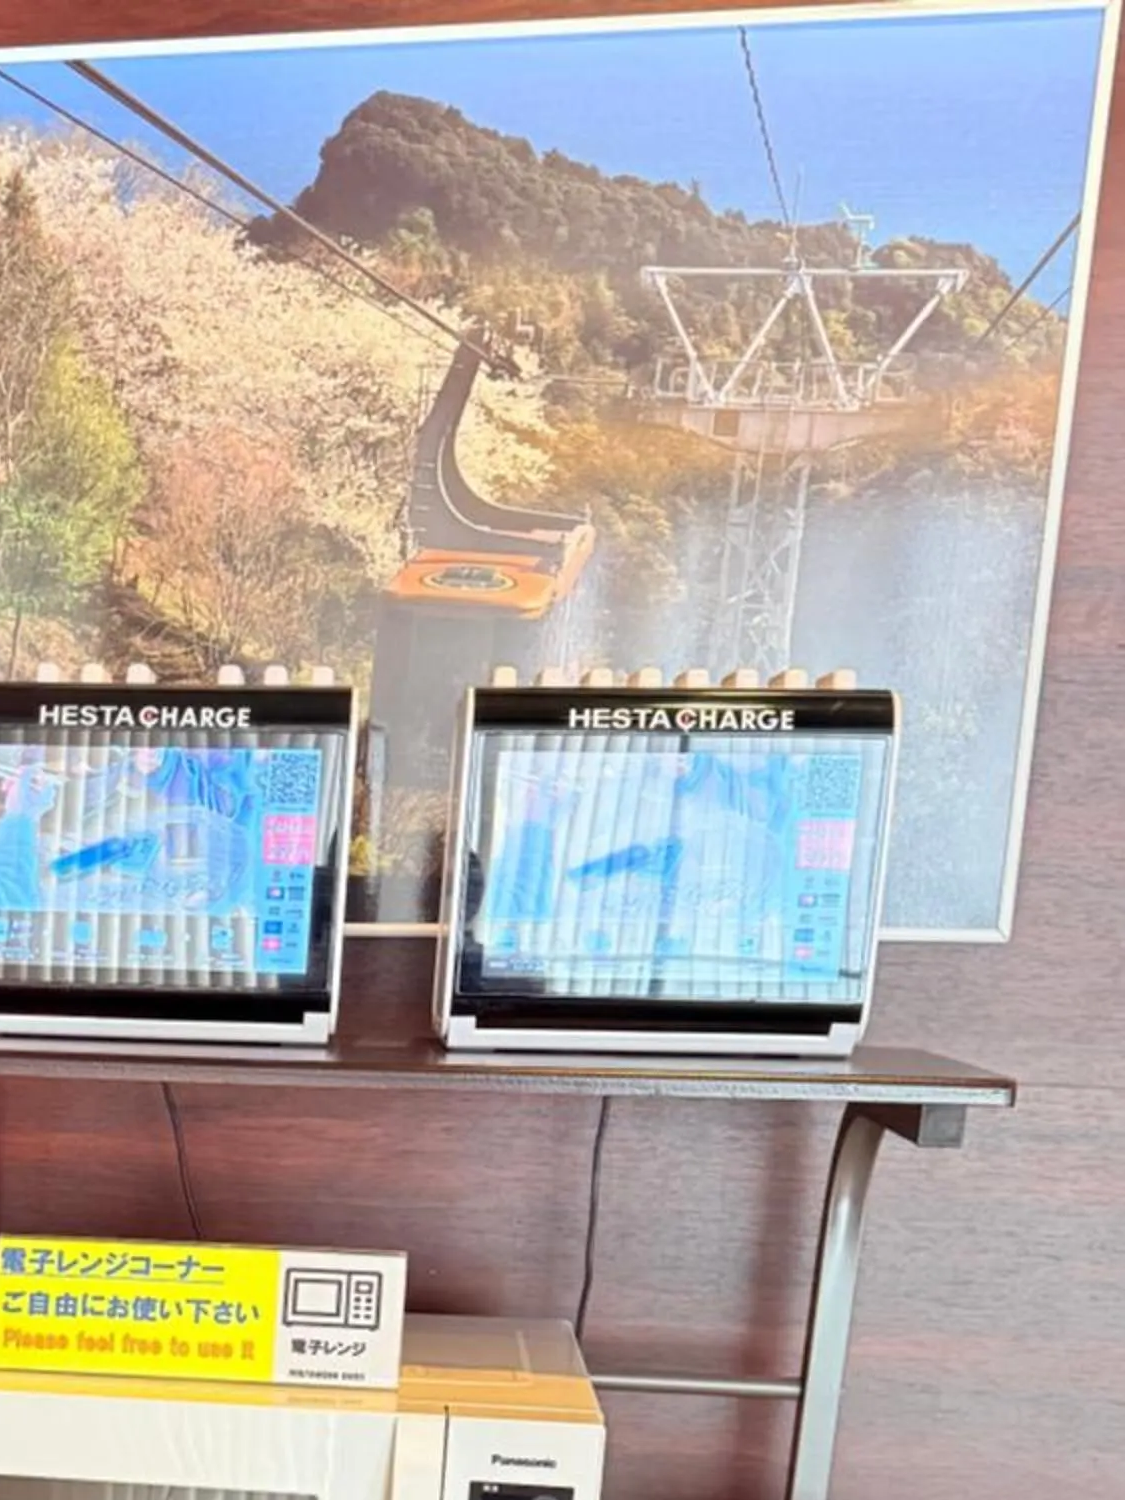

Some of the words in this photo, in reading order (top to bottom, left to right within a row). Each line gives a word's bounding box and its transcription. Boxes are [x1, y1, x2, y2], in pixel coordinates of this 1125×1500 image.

[1, 1247, 225, 1279] 電子レンジコーナー
[2, 1290, 260, 1324] ご自由にお使い下さい
[3, 1327, 69, 1350] Please
[76, 1330, 115, 1352] feel
[121, 1332, 163, 1355] free
[170, 1335, 190, 1357] to
[197, 1340, 233, 1359] use
[291, 1338, 367, 1356] 電子レンジ
